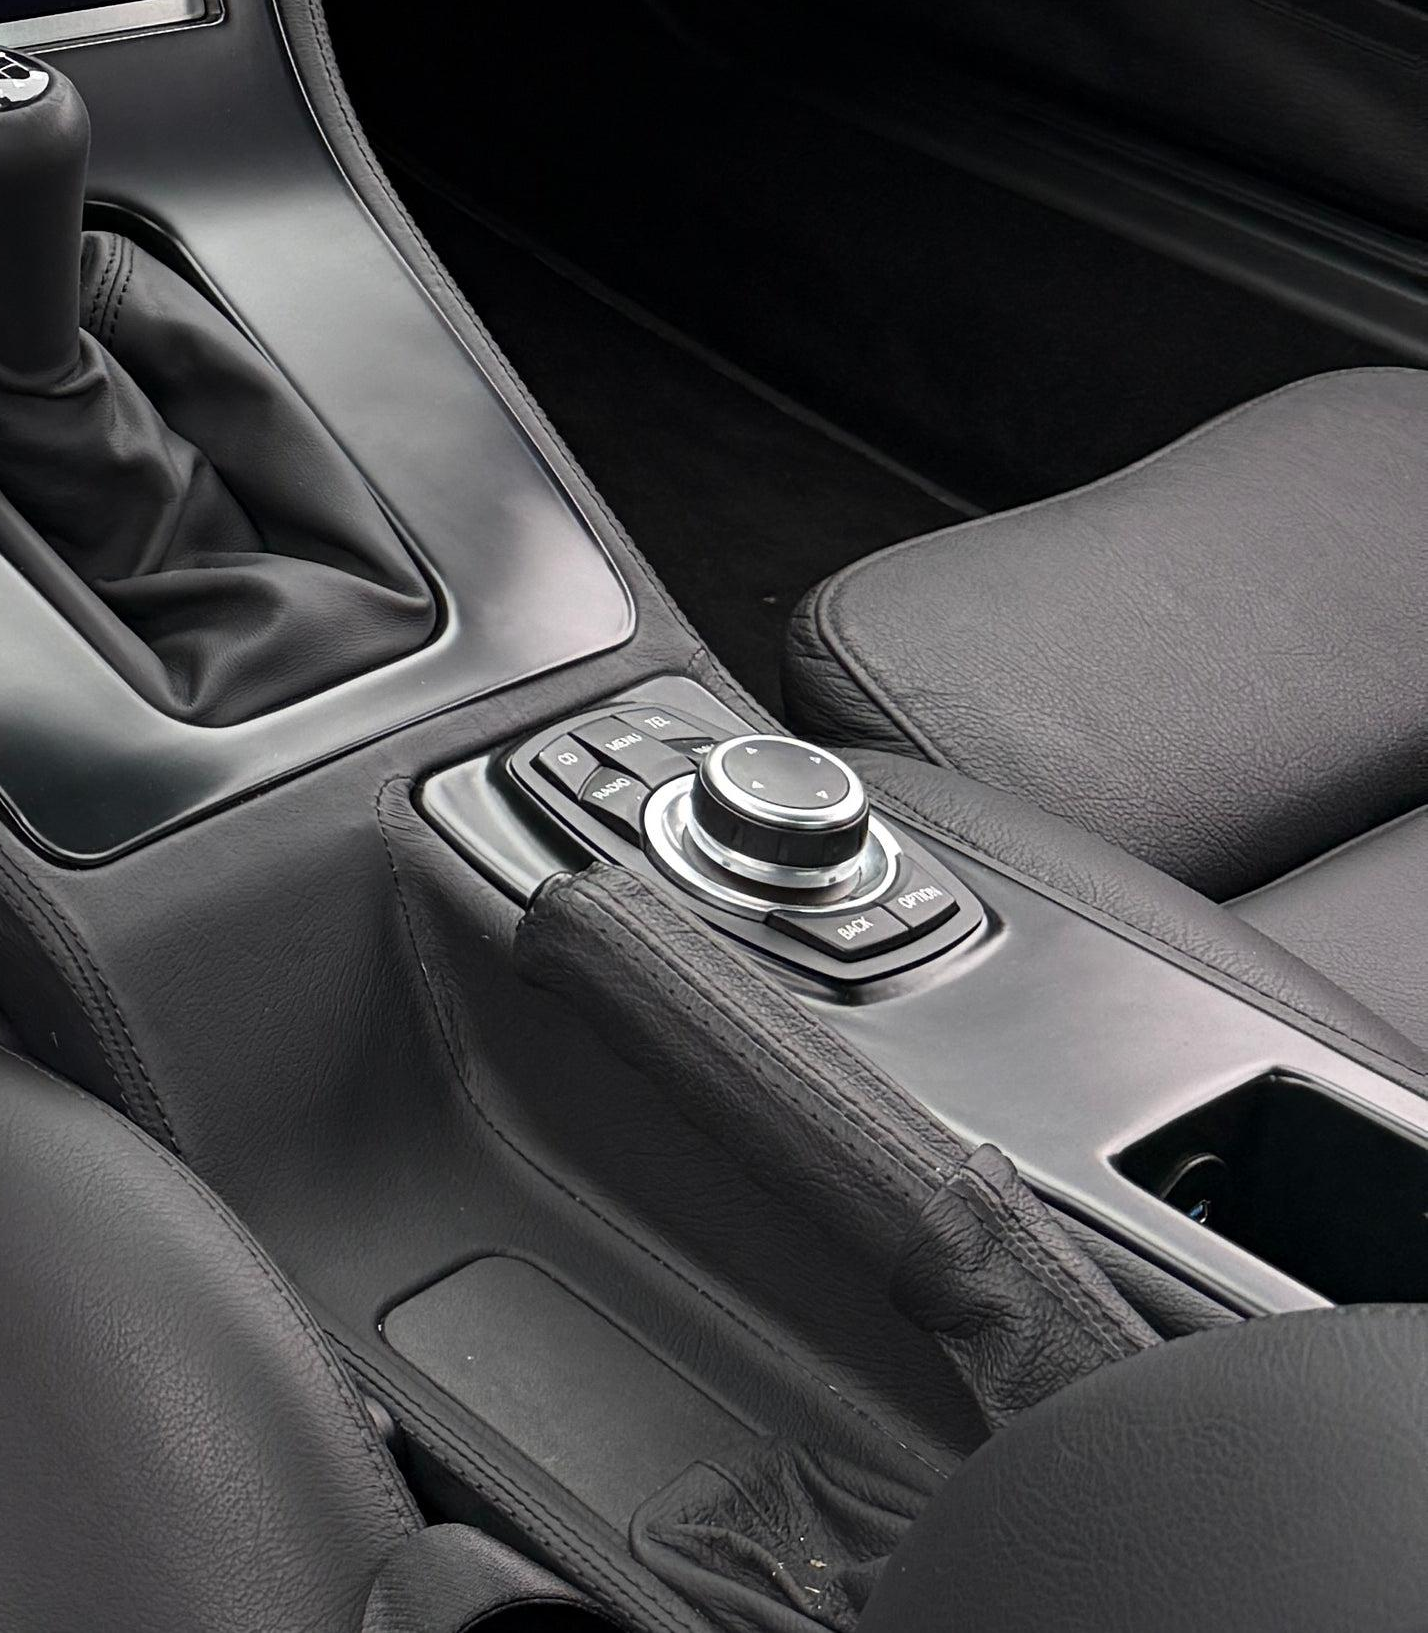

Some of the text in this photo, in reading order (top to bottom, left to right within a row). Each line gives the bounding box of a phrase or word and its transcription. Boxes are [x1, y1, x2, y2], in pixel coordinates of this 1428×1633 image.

[644, 716, 671, 729] TEL
[605, 733, 642, 751] MENU
[558, 753, 578, 765] CD
[592, 778, 631, 800] RADIO
[898, 886, 943, 909] OPTION
[837, 916, 874, 940] BACK
